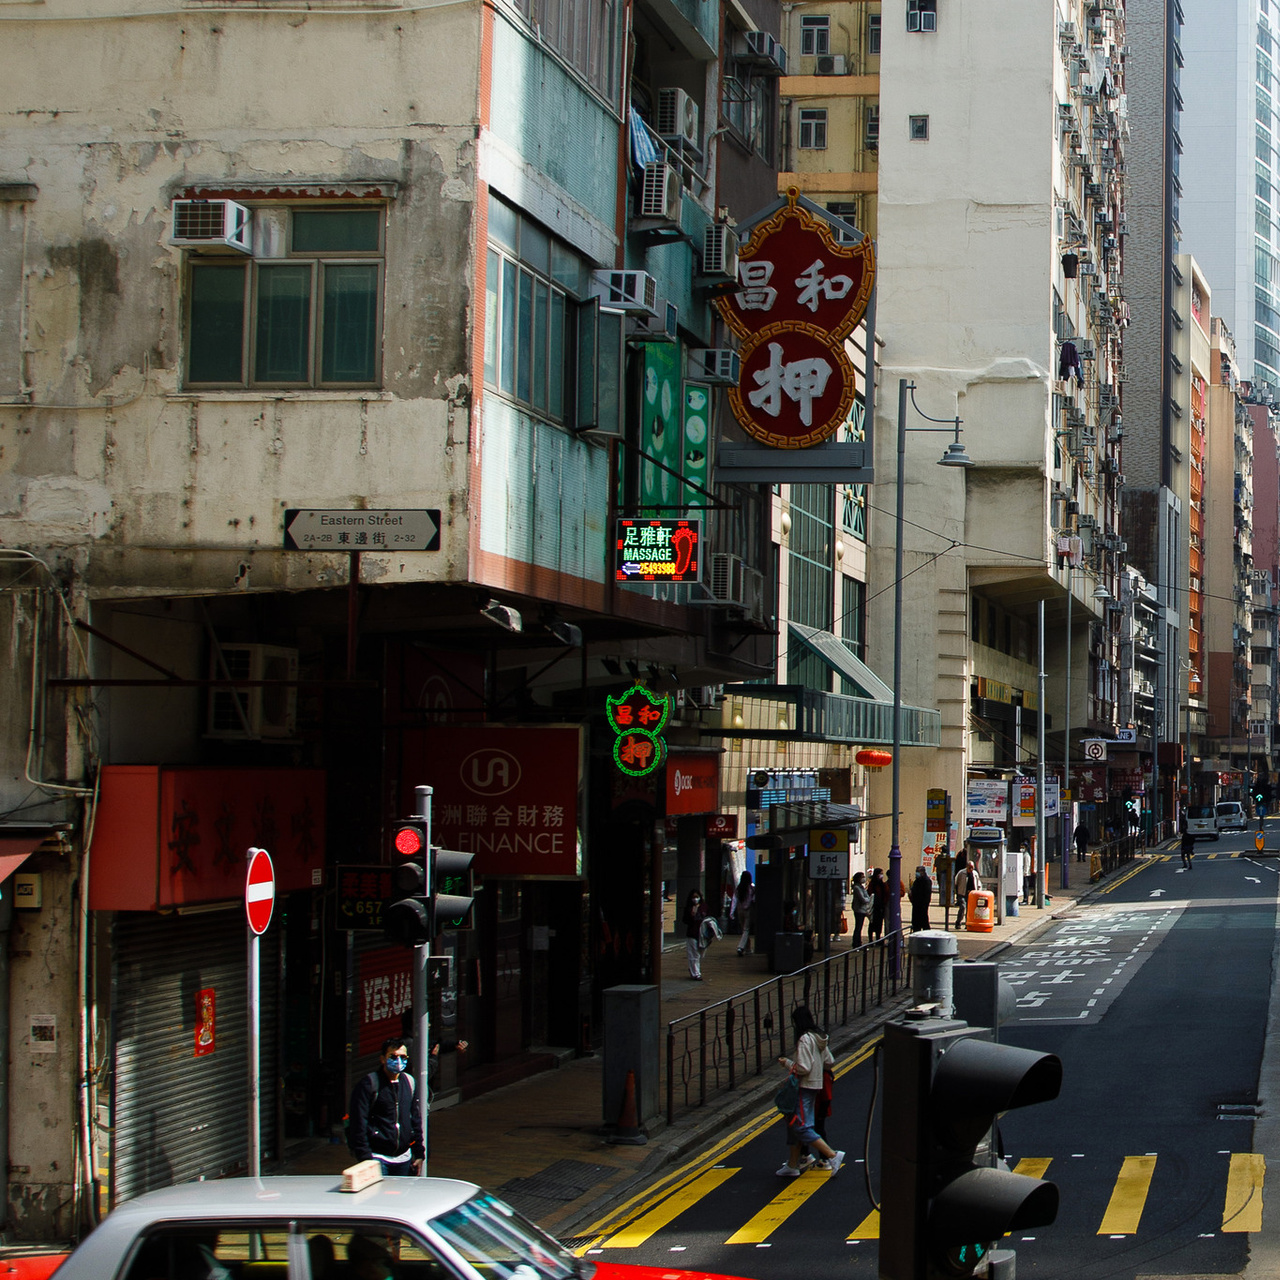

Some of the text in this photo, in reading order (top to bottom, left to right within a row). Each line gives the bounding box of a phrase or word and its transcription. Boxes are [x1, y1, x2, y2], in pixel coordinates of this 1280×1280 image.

[734, 261, 853, 313] 昌和
[748, 342, 832, 426] 押
[321, 515, 403, 526] Eastern Street
[304, 532, 416, 545] 2A-2B 東邊街 2-32
[624, 526, 673, 547] 足雅軒
[624, 548, 673, 561] MASSAGE
[616, 705, 660, 725] 昌和
[620, 736, 653, 768] 押
[472, 759, 509, 788] UA
[432, 804, 565, 828] 洲聯合財務
[459, 832, 565, 855] FINANCE
[820, 855, 839, 864] End
[816, 865, 841, 877] 終止
[999, 959, 1113, 967] STOP
[1020, 949, 1111, 959] BUS
